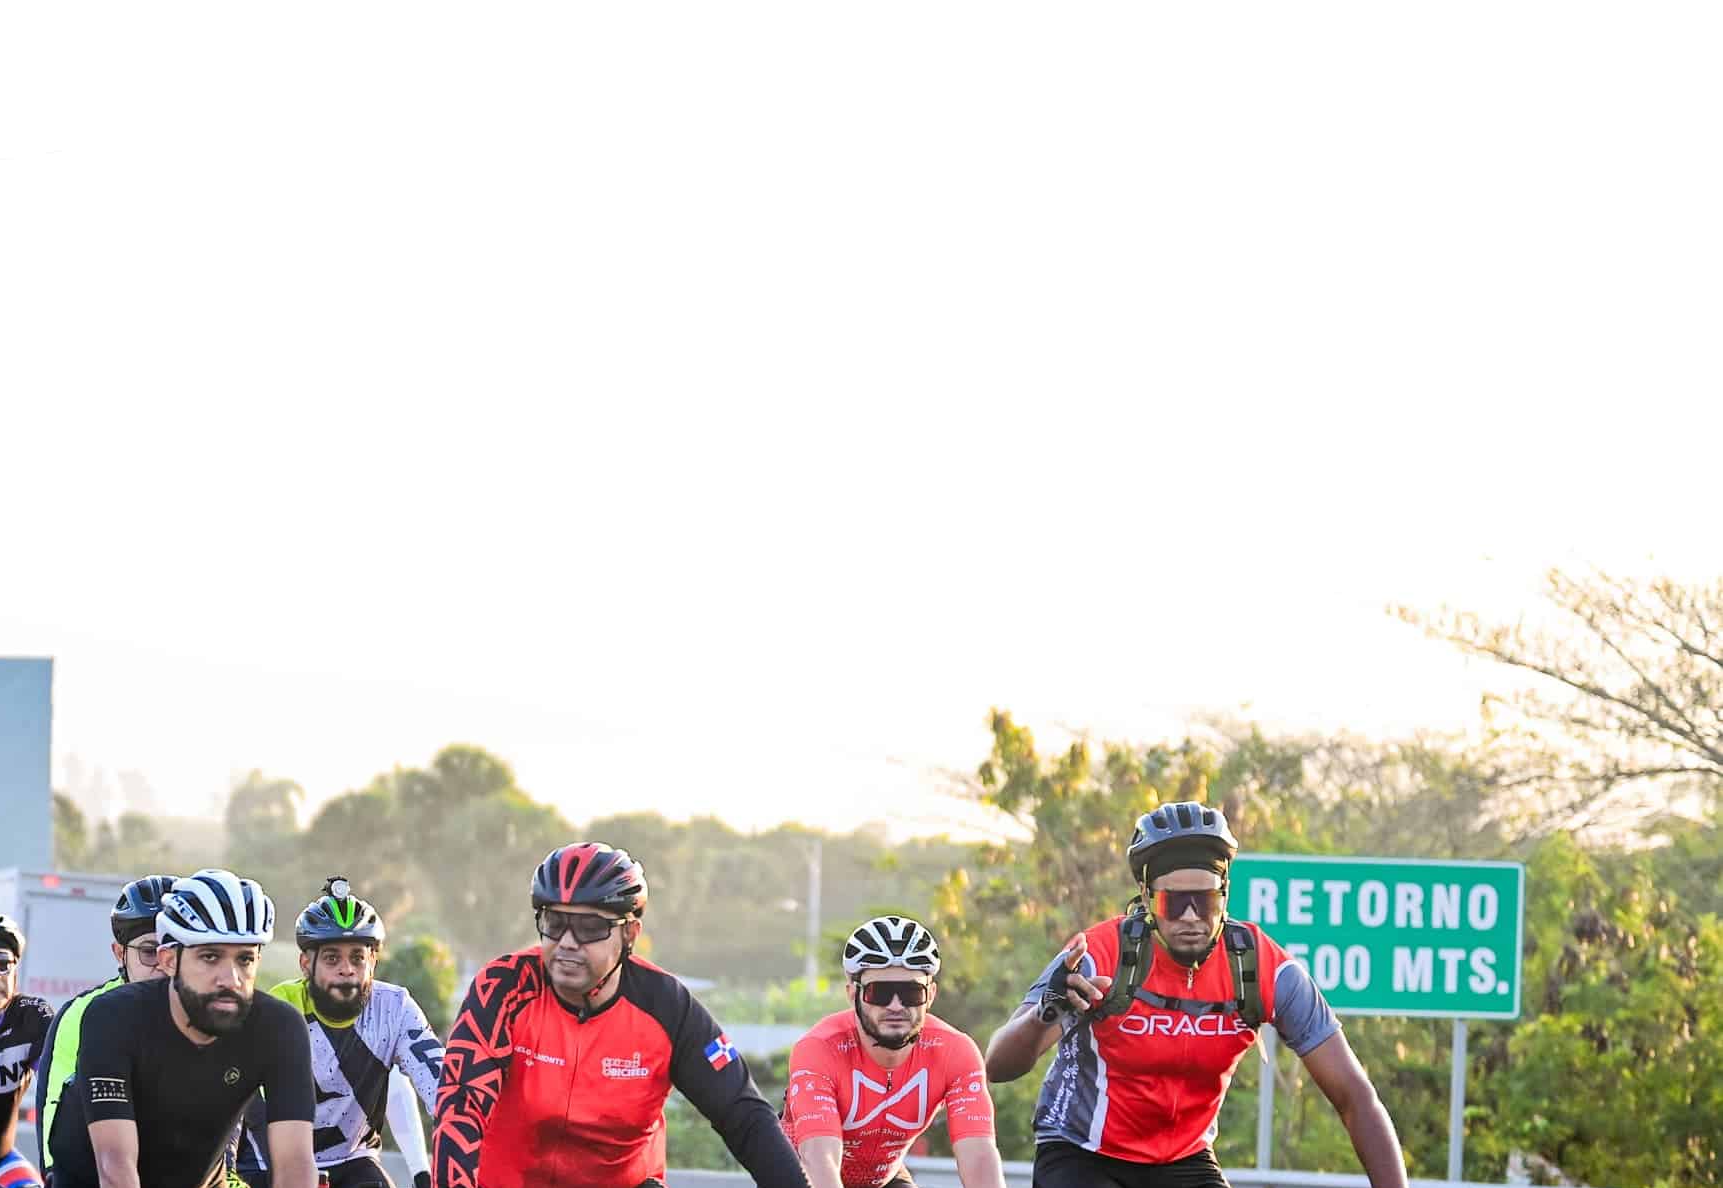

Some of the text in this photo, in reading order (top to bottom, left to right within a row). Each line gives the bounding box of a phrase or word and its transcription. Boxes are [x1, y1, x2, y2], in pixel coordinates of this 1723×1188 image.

[1247, 877, 1499, 931] RETORNO
[1391, 945, 1510, 995] MTS.
[1118, 1014, 1247, 1036] ORACLE
